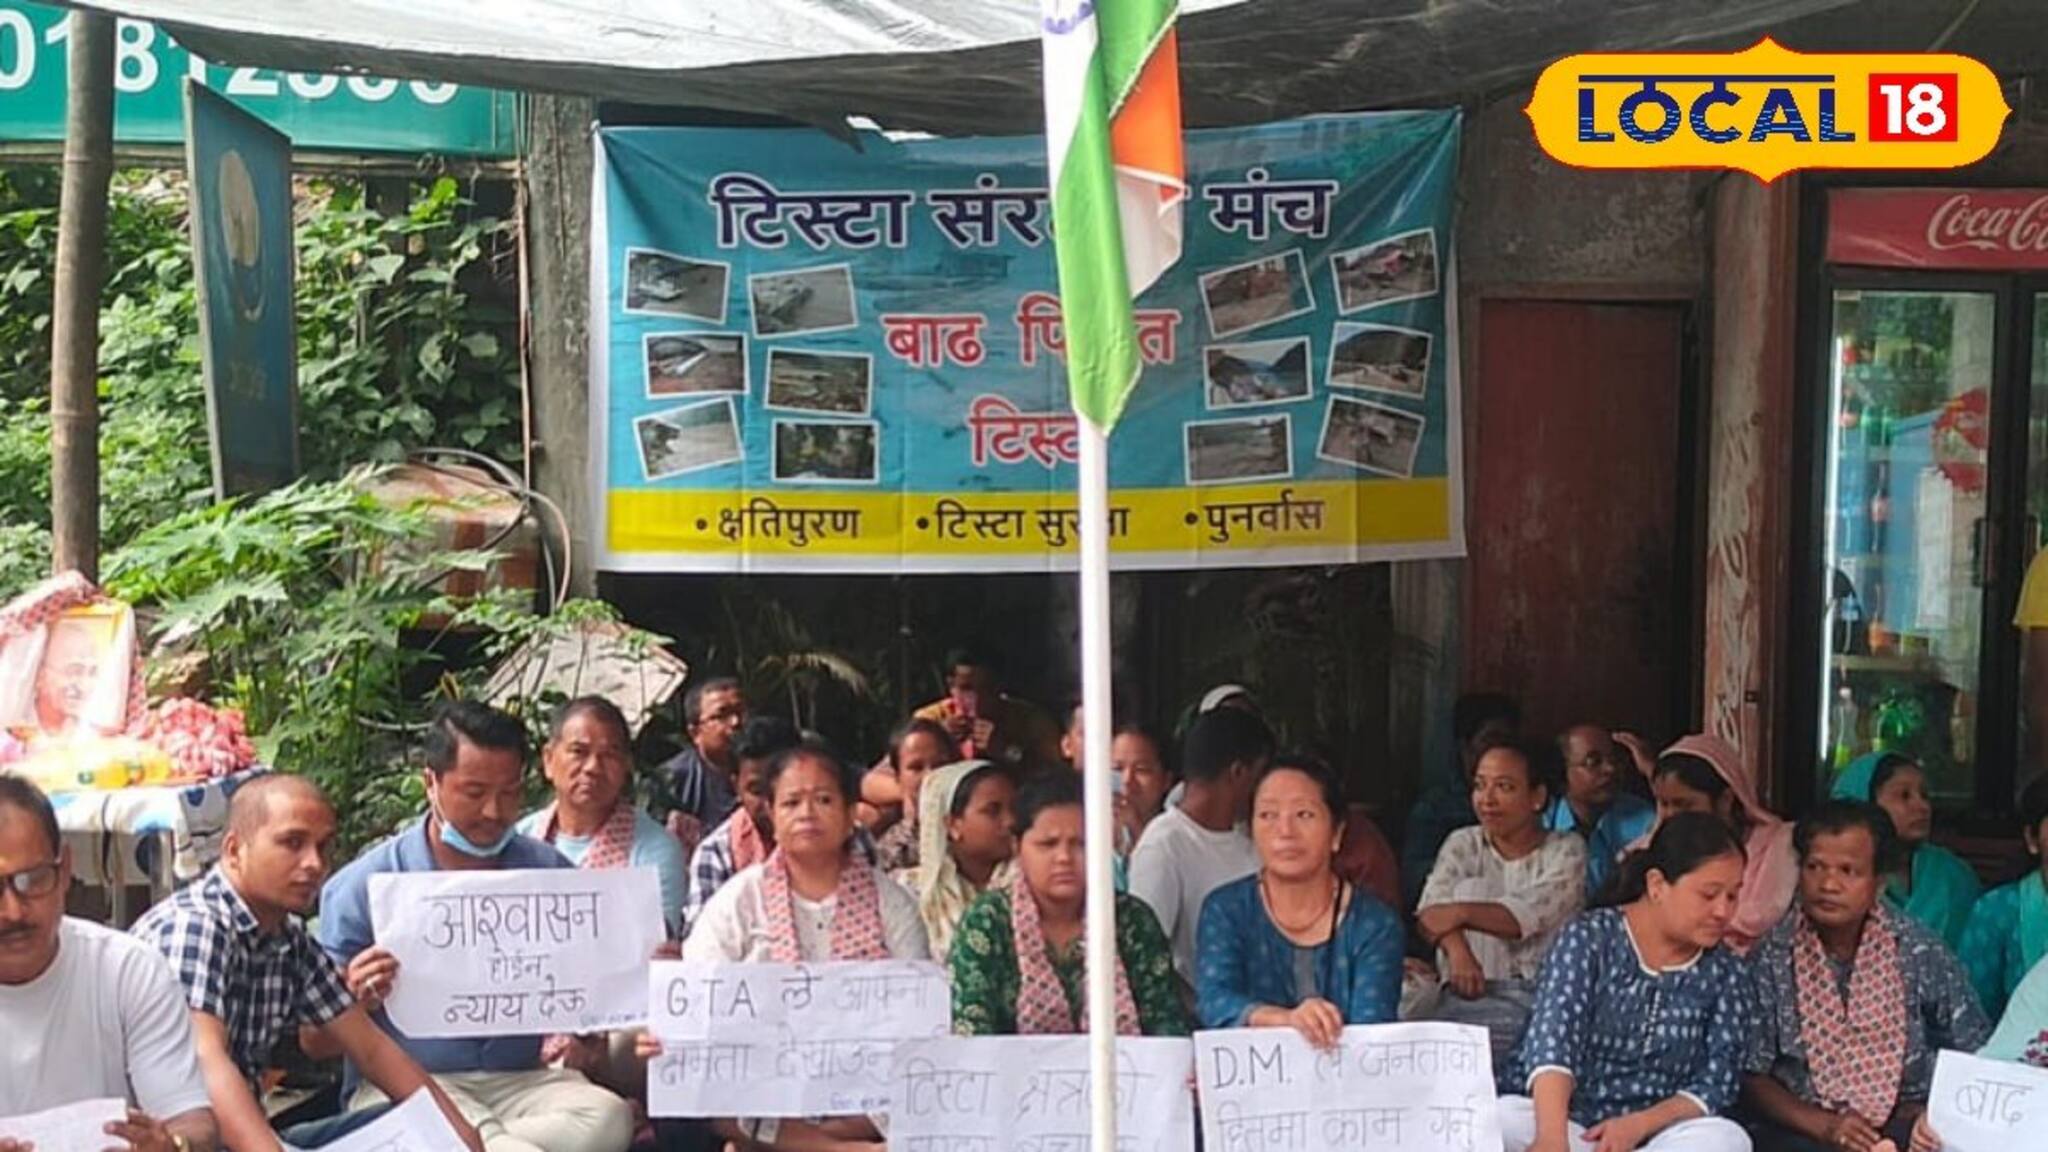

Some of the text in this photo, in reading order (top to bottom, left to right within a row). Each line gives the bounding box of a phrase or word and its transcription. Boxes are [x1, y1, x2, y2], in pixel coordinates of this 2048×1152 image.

[710, 173, 914, 249] टिस्टा
[1204, 167, 1340, 240] मंच
[881, 313, 986, 367] बाढ
[718, 497, 860, 547] क्षतिपुरण
[936, 501, 1026, 539] टिस्टा
[1203, 489, 1325, 543] पुनर्वास
[443, 993, 530, 1024] न्याय
[1212, 1042, 1294, 1090] D.M.
